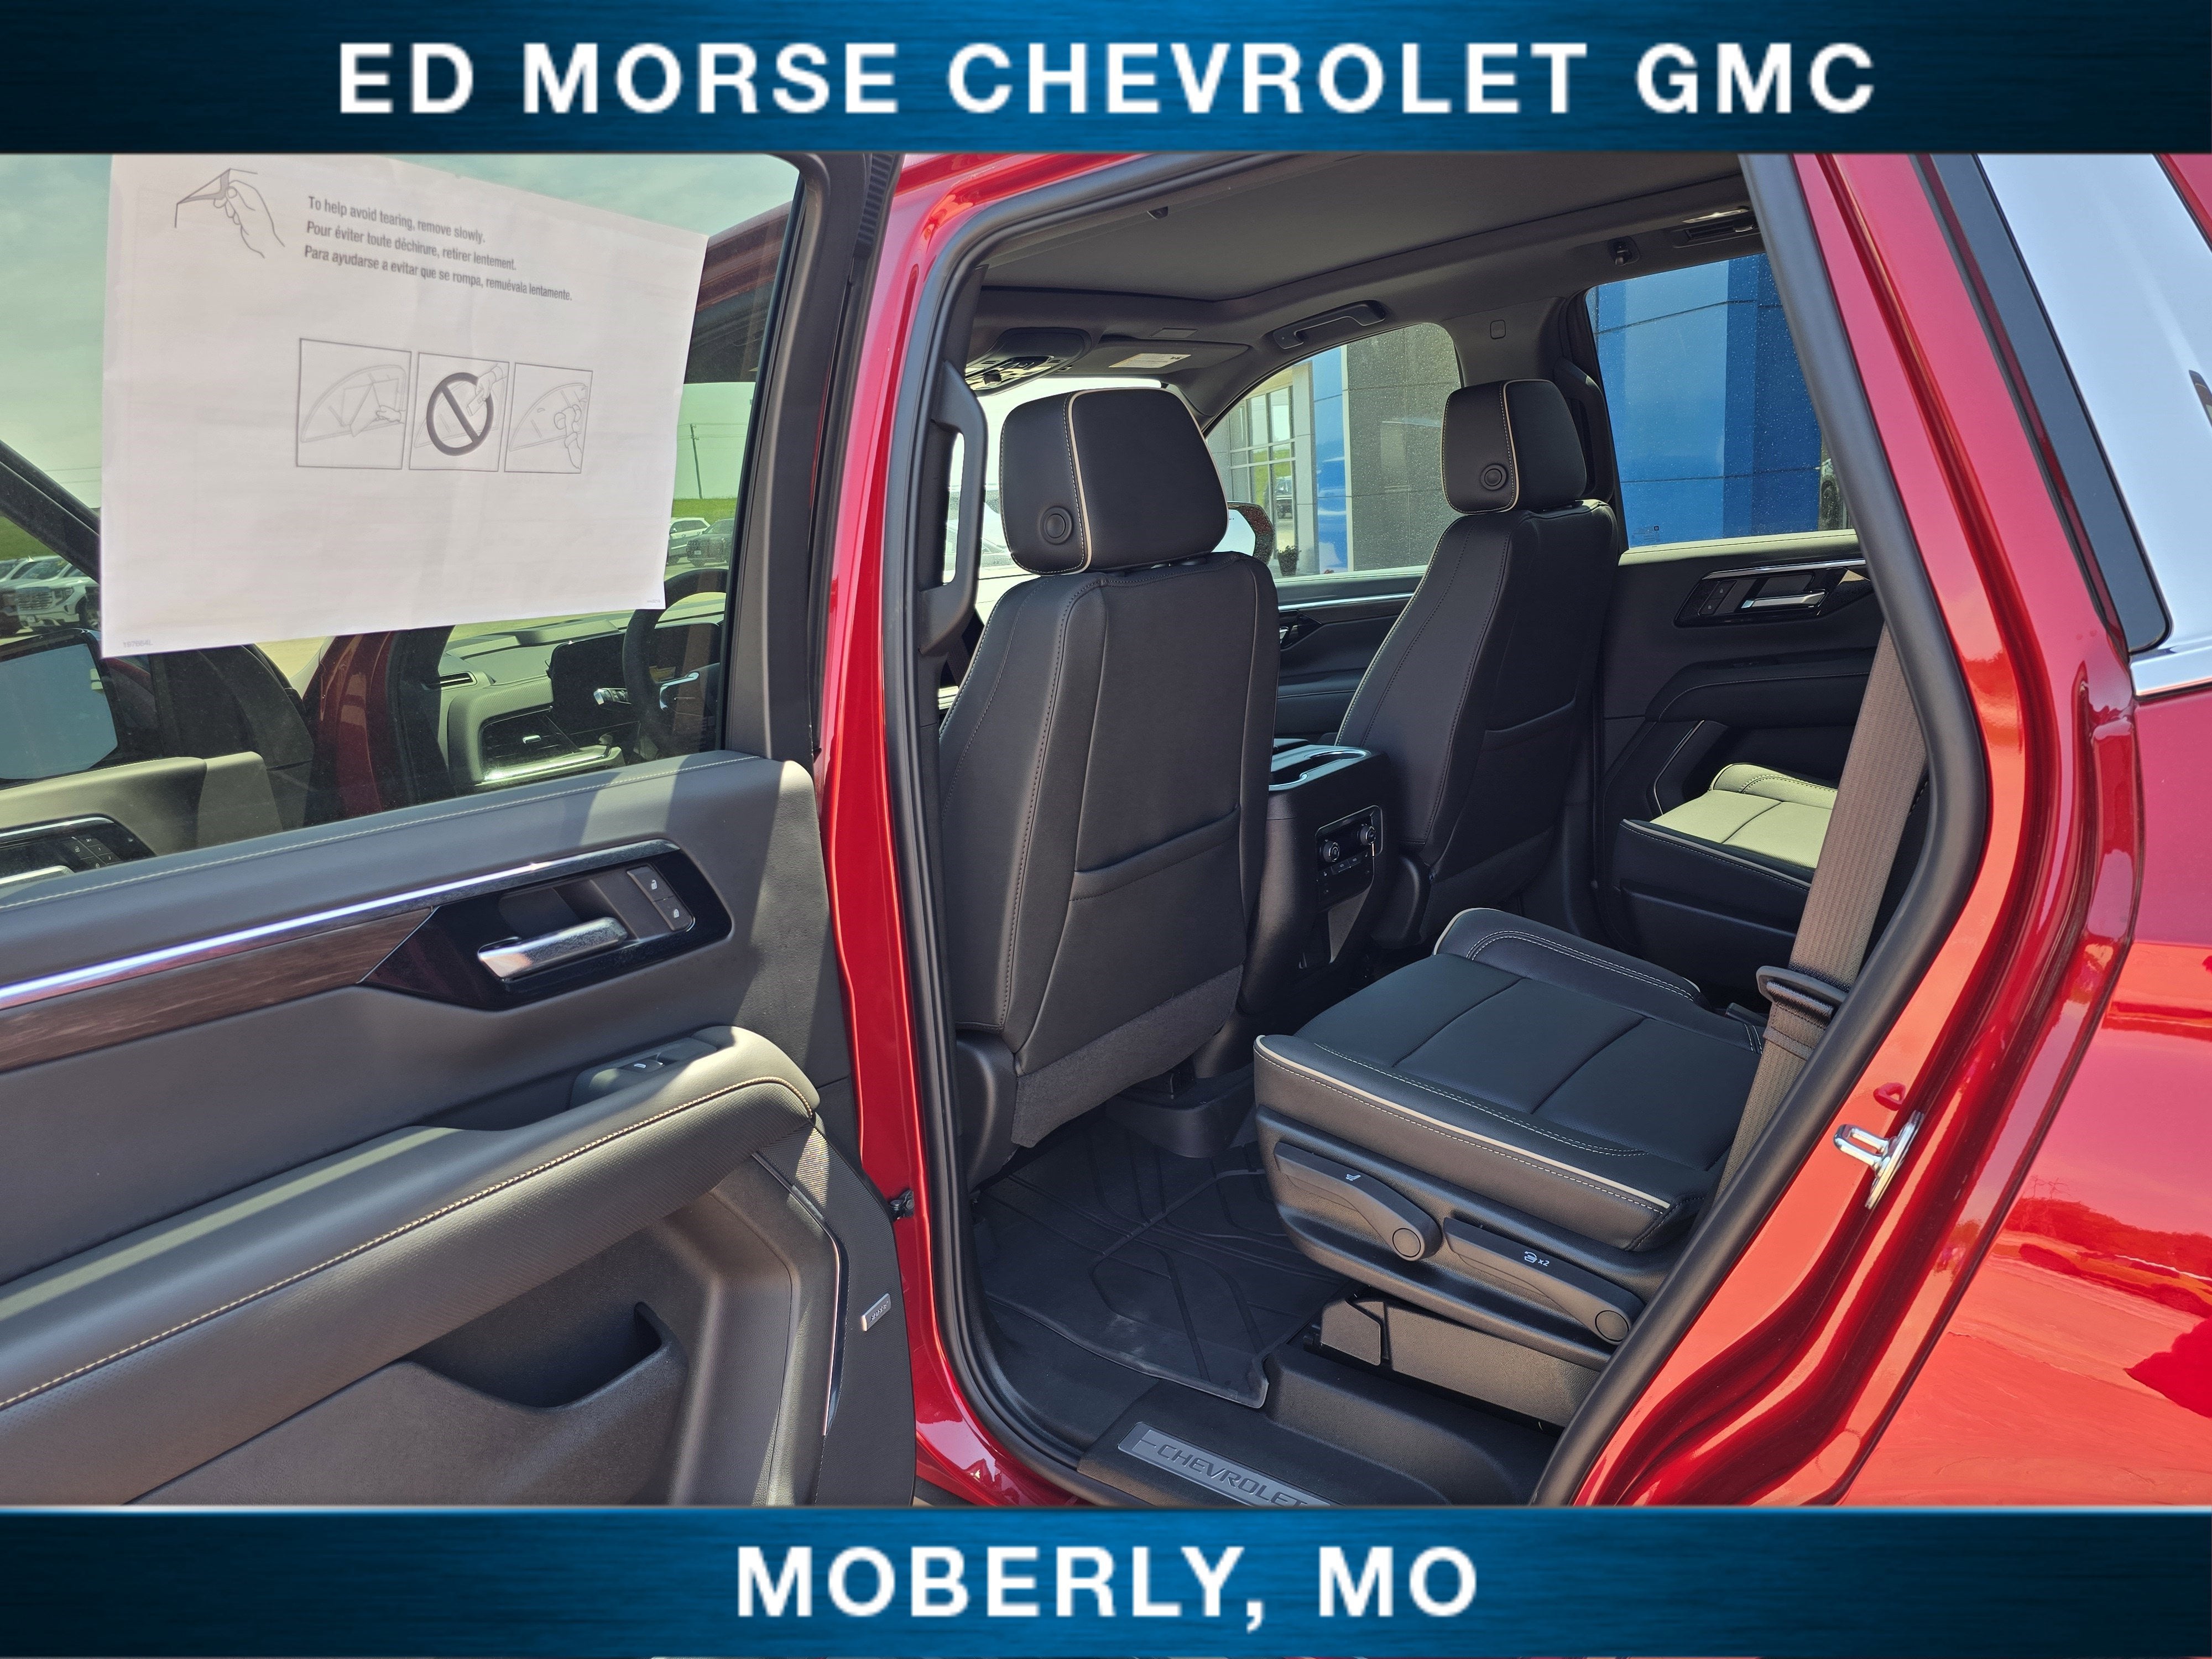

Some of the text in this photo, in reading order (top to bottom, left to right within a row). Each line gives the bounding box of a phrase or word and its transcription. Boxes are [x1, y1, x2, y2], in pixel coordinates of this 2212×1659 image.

[308, 196, 486, 244] To help avoid tearing, remove slowly.
[307, 220, 517, 270] Pour éviter toute déchirure, retirer lentement.
[305, 245, 572, 301] Para ayudarse a evitar que se rompa, remuévala lentamente.
[1538, 1259, 1550, 1267] x2
